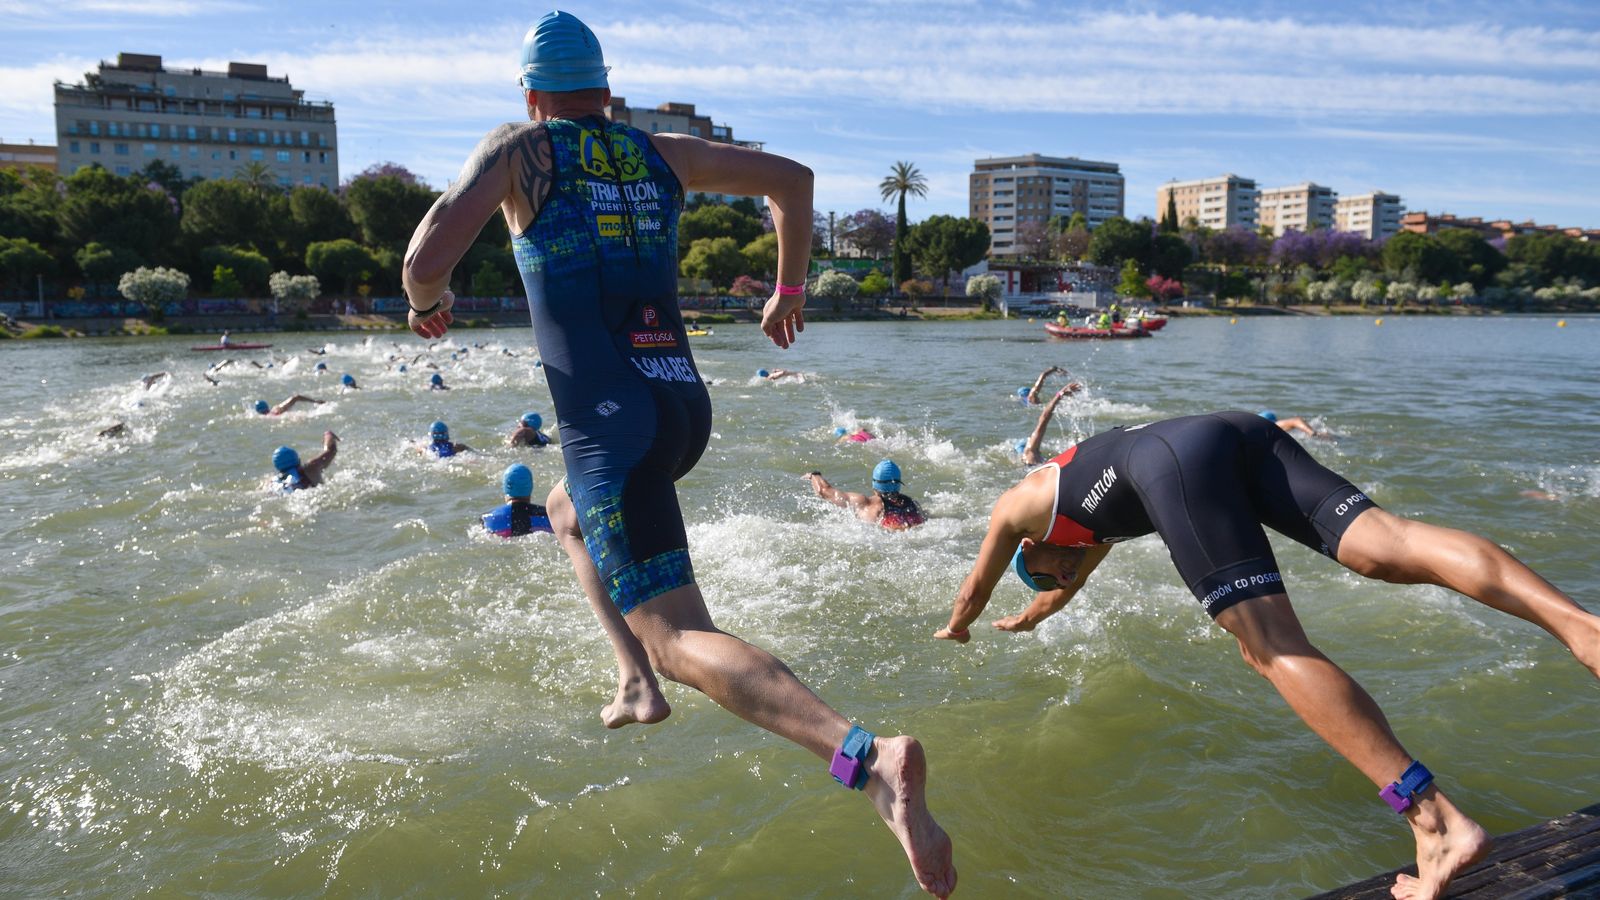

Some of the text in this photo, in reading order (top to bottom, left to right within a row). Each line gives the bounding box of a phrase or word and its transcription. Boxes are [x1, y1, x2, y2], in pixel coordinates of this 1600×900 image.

[587, 179, 659, 201] TRIATLÓN
[634, 201, 660, 211] GENIL
[634, 333, 677, 343] PETROSOL
[1081, 465, 1117, 514] TRIATLÓN
[1335, 503, 1349, 516] CD
[1234, 578, 1249, 589] CD
